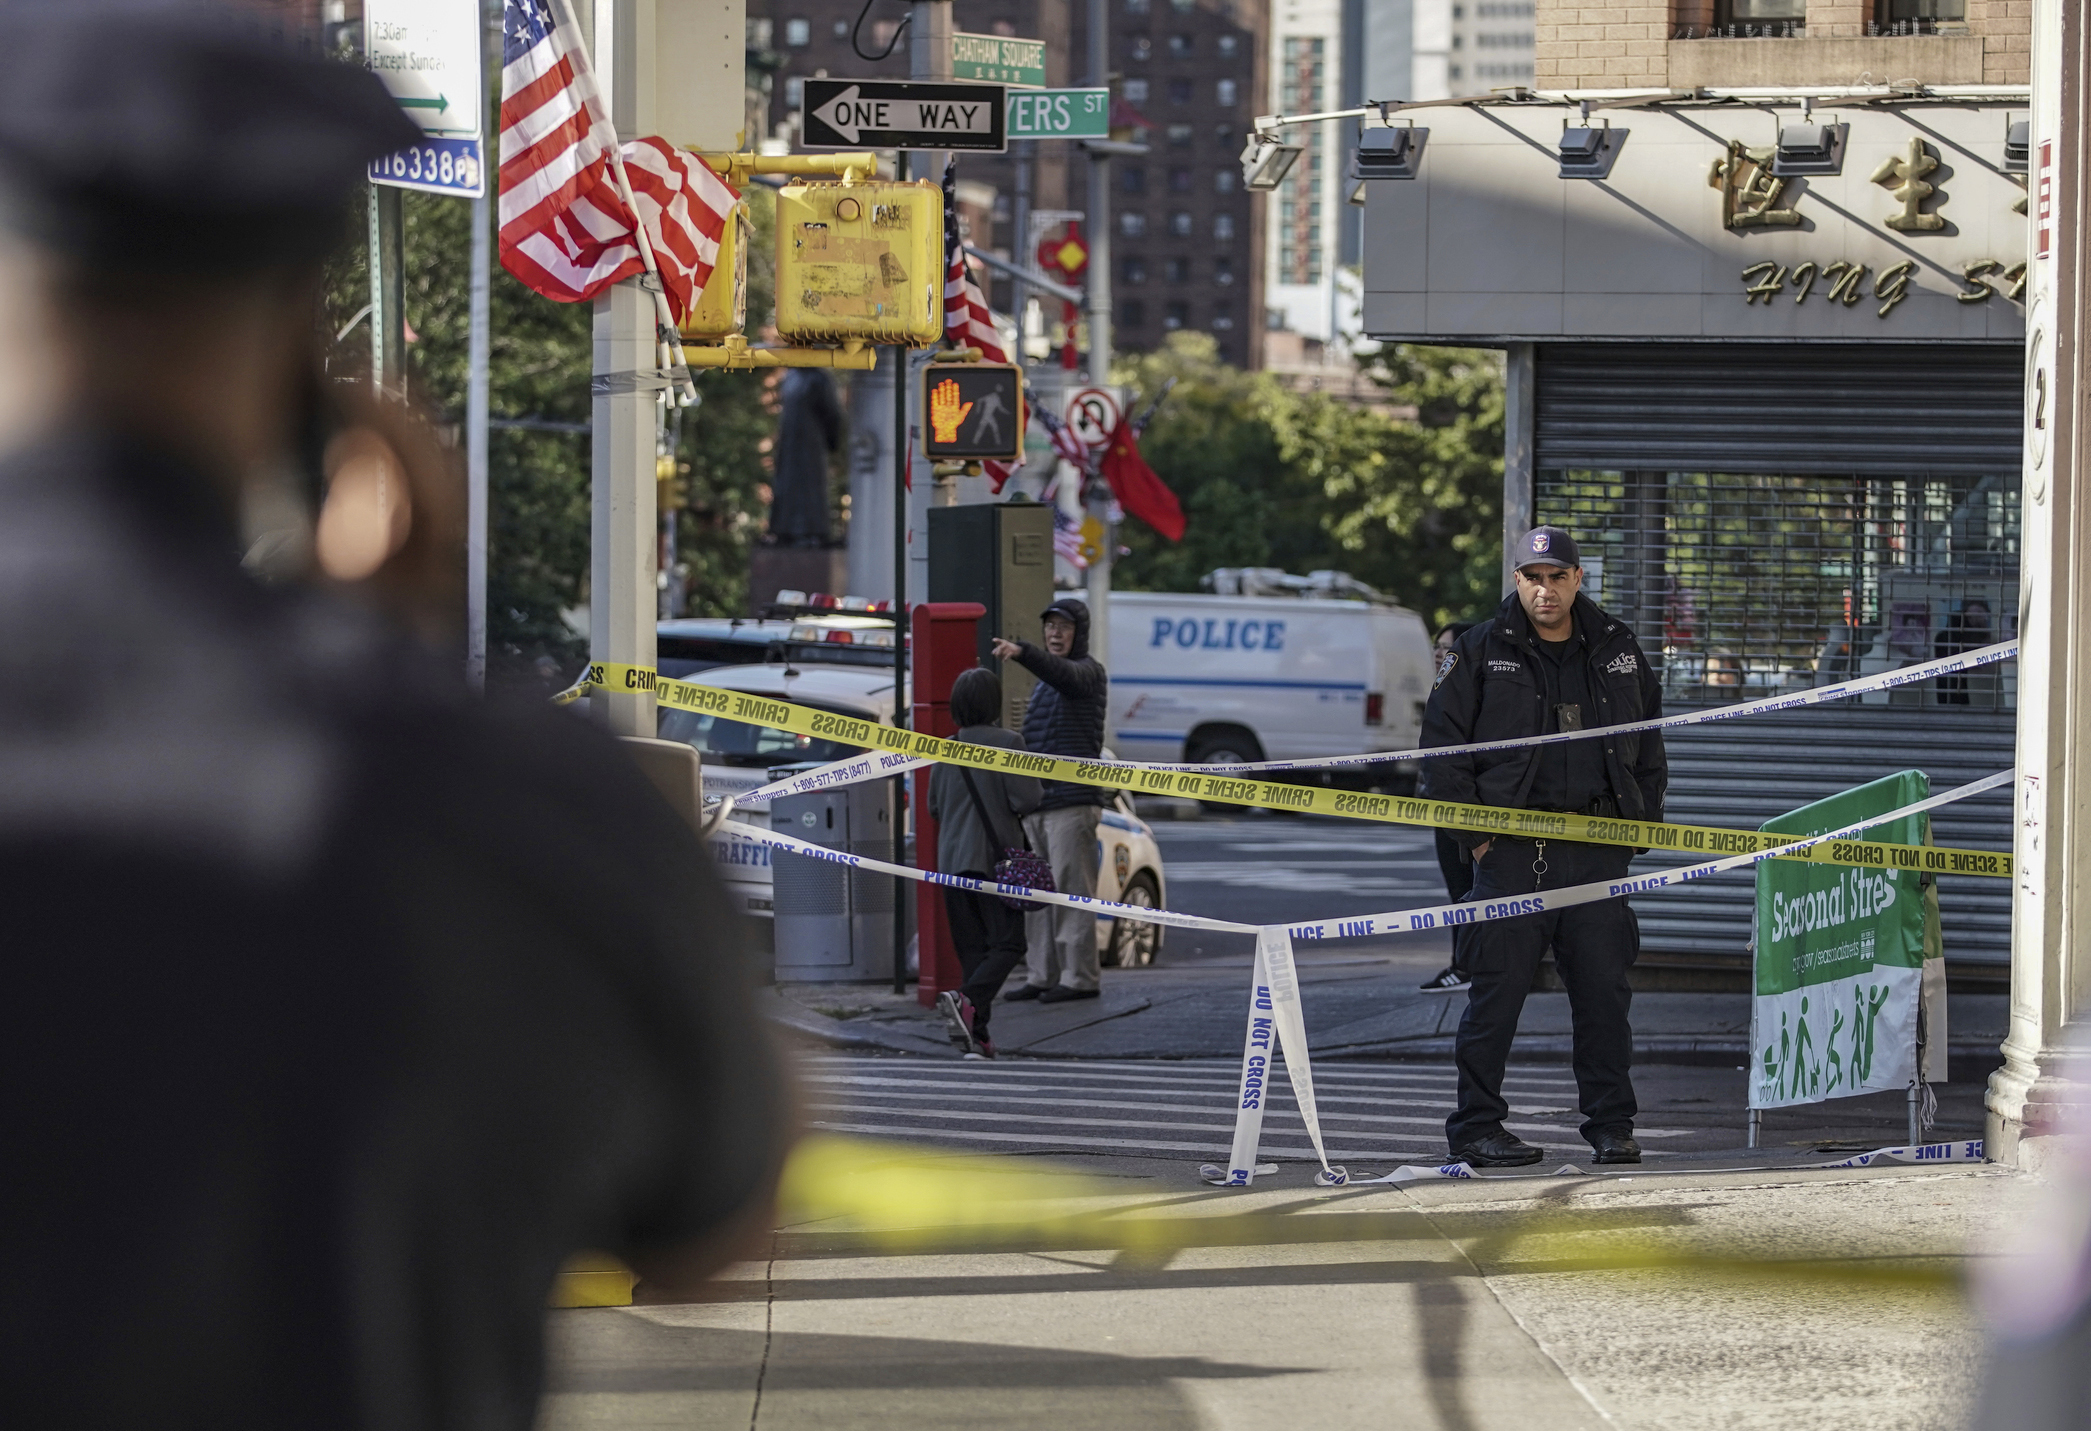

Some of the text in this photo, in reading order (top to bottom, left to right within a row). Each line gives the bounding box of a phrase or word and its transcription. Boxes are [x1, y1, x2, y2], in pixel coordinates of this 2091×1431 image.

[952, 37, 1044, 70] CHATHAM SQUARE
[835, 101, 979, 130] ONE WAY
[1085, 93, 1105, 113] ST
[1741, 260, 1915, 318] HING
[1151, 617, 1287, 650] POLICE
[1488, 660, 1521, 668] MALDONADO
[1753, 705, 1763, 714] DO
[1764, 702, 1780, 712] NOT
[1781, 697, 1807, 709] CROSS
[1976, 651, 2002, 665] POLICE
[793, 768, 849, 792] 1-800-577-TIPS
[849, 760, 872, 781] (8477)
[880, 752, 905, 770] POLICE
[709, 840, 773, 867] TRAFFI
[924, 870, 983, 891] POLICE
[996, 882, 1033, 897] LINE
[1338, 919, 1375, 937] LINE
[1410, 912, 1435, 930] DO
[1442, 907, 1477, 926] NOT
[1485, 897, 1545, 919] CROSS
[1609, 875, 1669, 897] POLICE
[1771, 872, 1846, 943] Seasonal
[1241, 985, 1273, 1110] DO NOT CROSS
